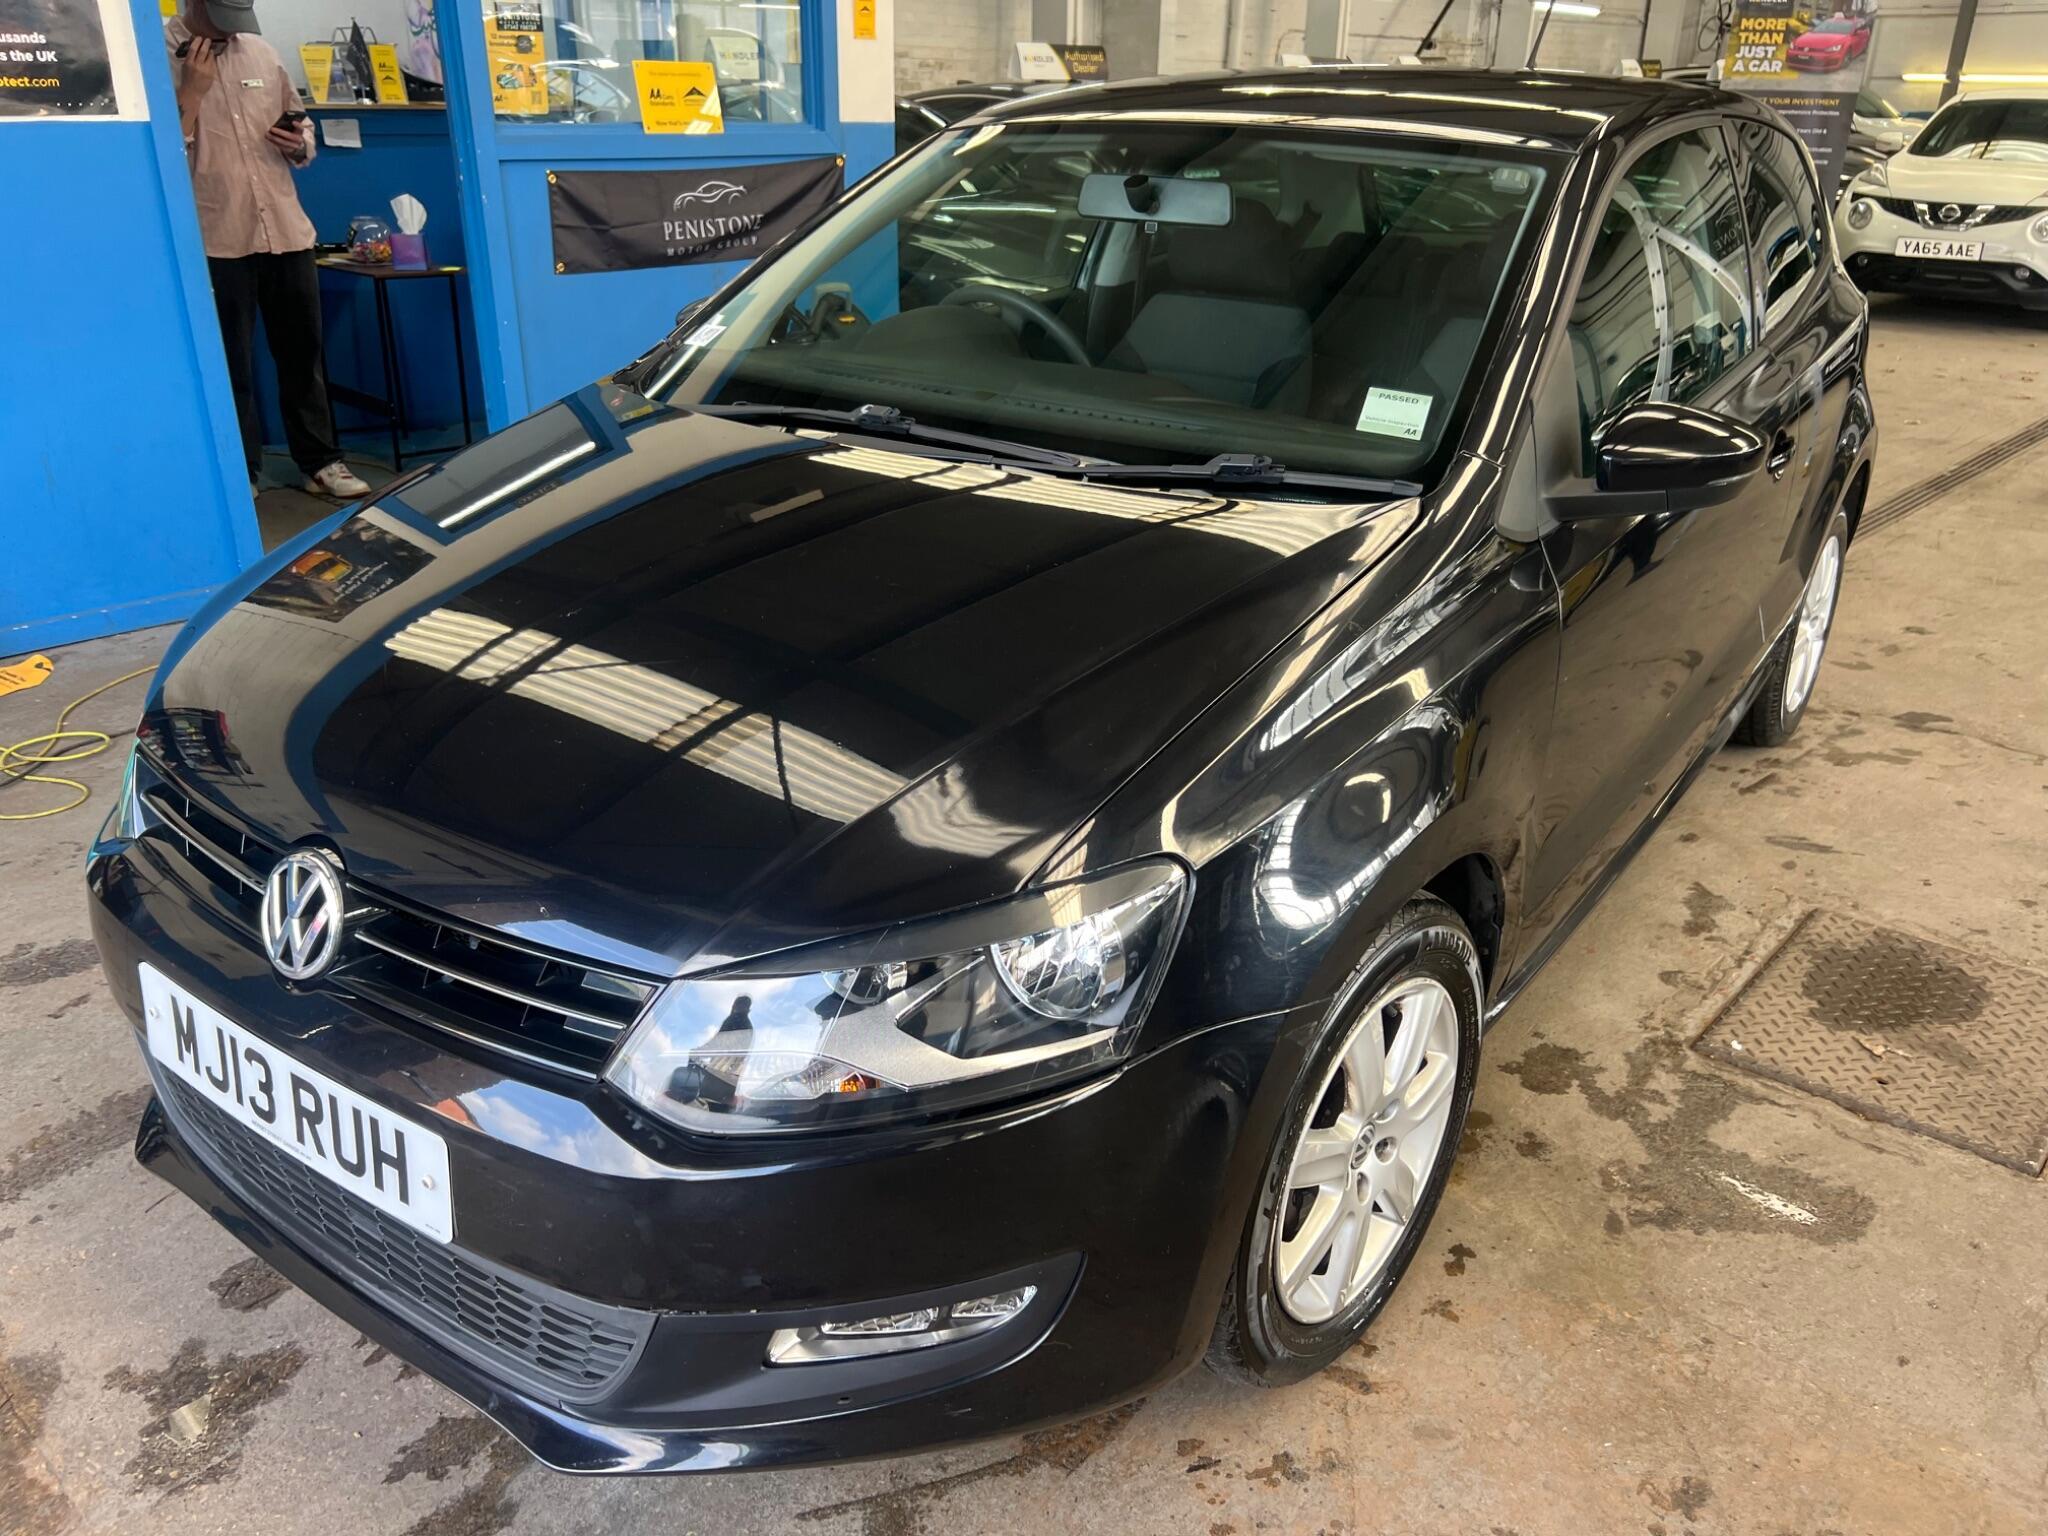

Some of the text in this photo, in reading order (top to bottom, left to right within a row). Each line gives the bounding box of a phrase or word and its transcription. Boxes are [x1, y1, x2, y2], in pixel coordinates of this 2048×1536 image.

[1740, 18, 1787, 30] MORE
[1738, 32, 1784, 44] THAN
[9, 50, 34, 62] the
[35, 50, 58, 62] UK
[1735, 46, 1776, 58] JUST
[1733, 60, 1782, 72] A CAR
[650, 87, 661, 99] AA
[1769, 97, 1790, 106] YOUR
[1791, 98, 1840, 107] INVESTMENT
[663, 214, 764, 240] PENISTONE
[1904, 240, 1976, 257] YA65 AAE
[1379, 393, 1419, 404] PASSED
[1404, 428, 1417, 437] AA
[171, 993, 410, 1207] MJ13 RUH
